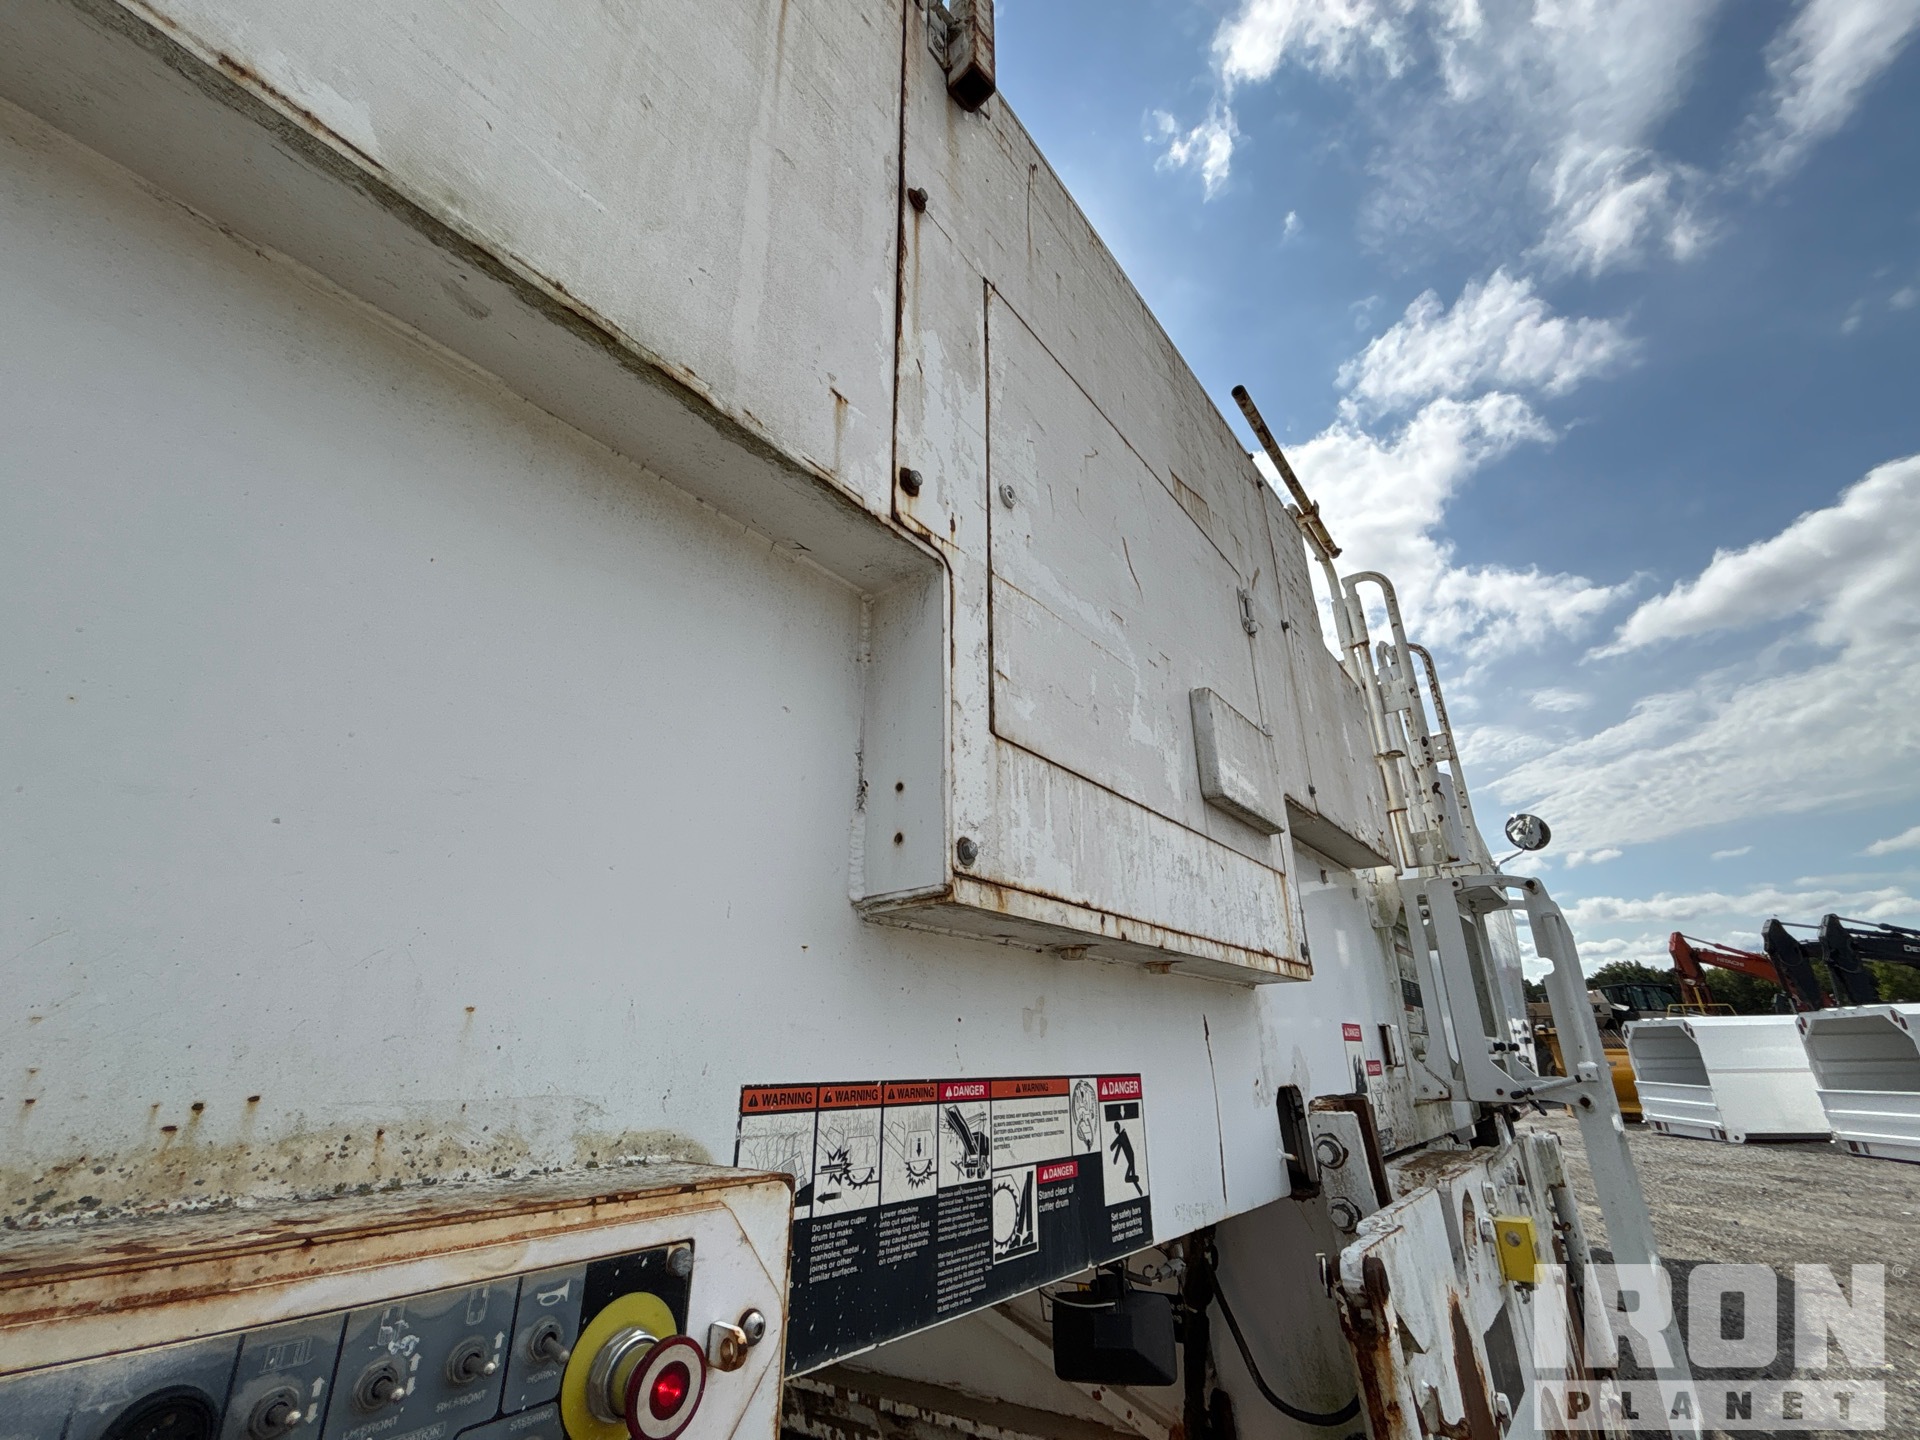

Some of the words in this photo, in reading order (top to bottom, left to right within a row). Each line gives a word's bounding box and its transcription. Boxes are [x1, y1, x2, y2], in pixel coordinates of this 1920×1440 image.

[1717, 956, 1744, 968] HITACHI
[897, 1087, 934, 1099] WARNING
[954, 1085, 984, 1096] DANGER
[1022, 1082, 1048, 1092] WARNING
[1109, 1081, 1139, 1094] DANGER
[762, 1092, 812, 1106] WARNING
[835, 1089, 878, 1102] WARNING
[1049, 1165, 1074, 1178] DANGER
[1039, 1188, 1054, 1200] Stand
[1055, 1187, 1067, 1197] clear
[1068, 1184, 1074, 1193] of
[1039, 1202, 1054, 1212] cutter
[1056, 1199, 1069, 1208] drum
[880, 1210, 896, 1220] Lower
[897, 1206, 918, 1215] machine
[1119, 1210, 1131, 1219] safety
[1132, 1206, 1141, 1215] bars
[812, 1224, 821, 1233] Do
[822, 1222, 832, 1230] not
[834, 1220, 849, 1228] allow
[850, 1216, 867, 1225] cutter
[879, 1220, 890, 1228] into
[891, 1218, 900, 1226] cut
[880, 1228, 901, 1237] entering
[902, 1225, 910, 1233] cut
[921, 1220, 930, 1229] fast
[1112, 1222, 1125, 1232] before
[1126, 1217, 1142, 1227] working
[811, 1234, 828, 1243] drum
[892, 1236, 907, 1244] cause
[1112, 1233, 1124, 1243] under
[810, 1241, 834, 1253] contact
[835, 1238, 848, 1247] with
[843, 1244, 859, 1255] metal
[886, 1244, 900, 1255] travel
[902, 1238, 928, 1250] backwards
[809, 1262, 827, 1275] joints
[836, 1258, 852, 1267] other
[879, 1258, 886, 1266] on
[887, 1254, 902, 1264] cutter
[809, 1272, 830, 1284] similar
